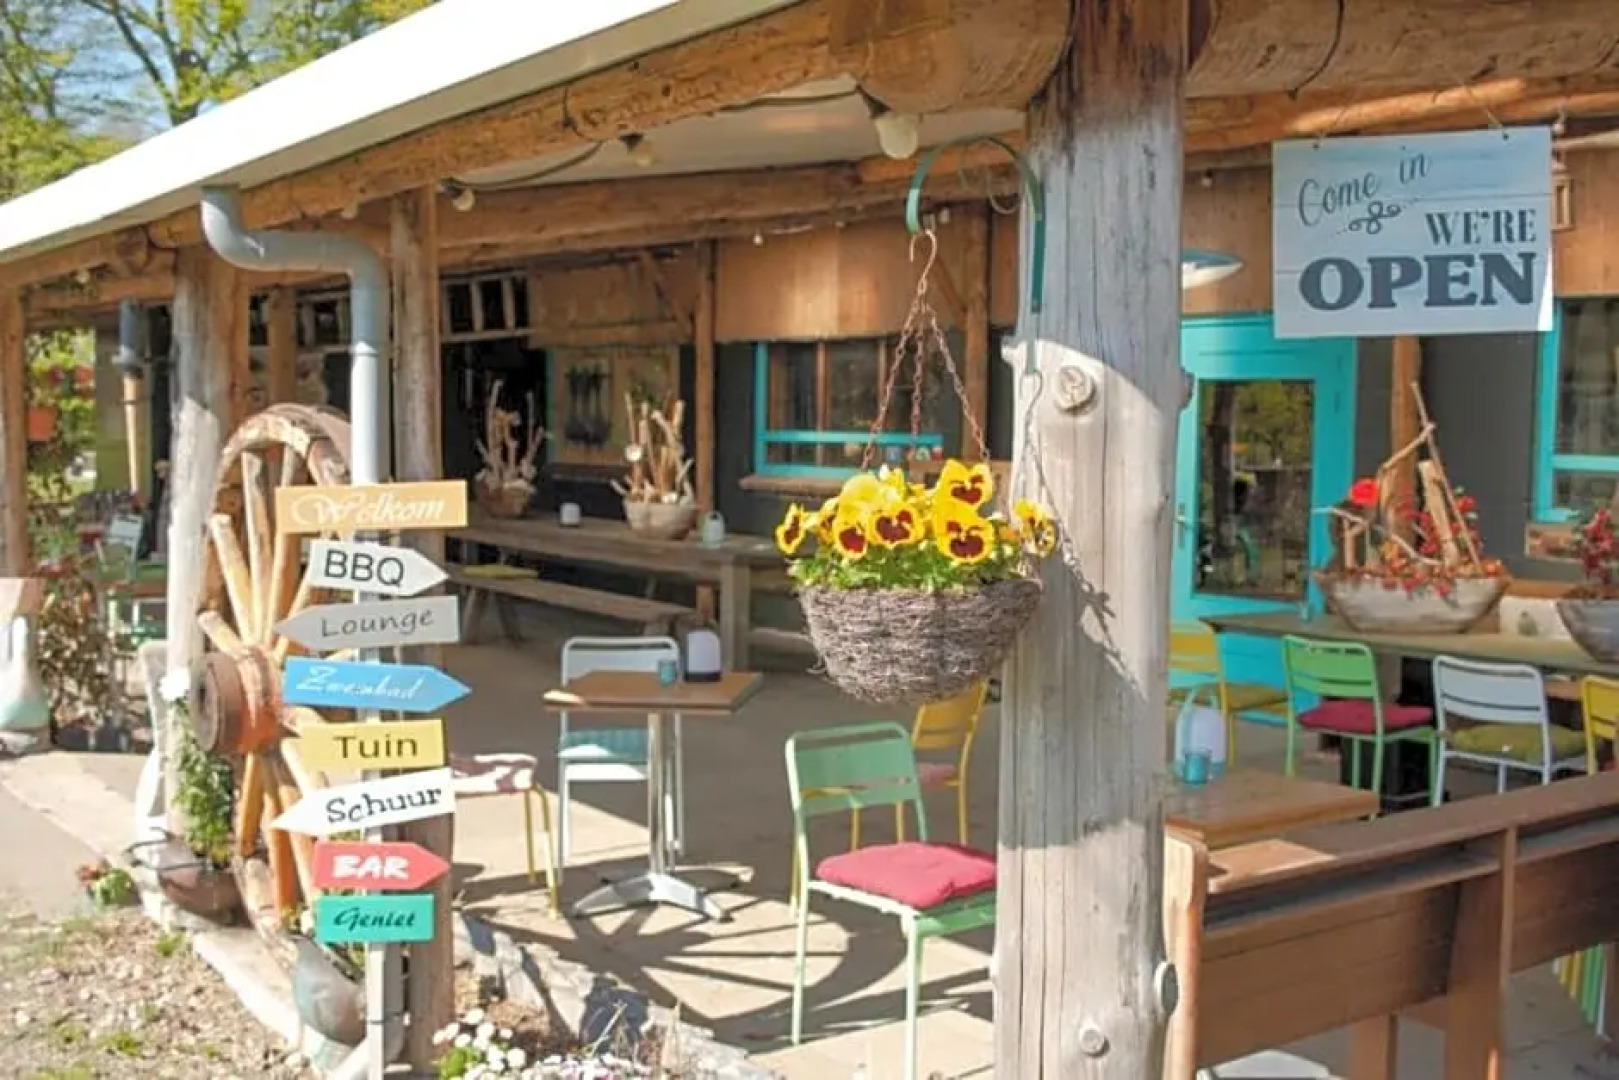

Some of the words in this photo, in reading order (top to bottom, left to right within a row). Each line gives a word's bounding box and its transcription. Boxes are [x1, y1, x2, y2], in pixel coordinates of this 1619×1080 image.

[1298, 172, 1381, 226] Come
[1399, 145, 1432, 184] in
[1424, 209, 1537, 246] WE'RE
[1299, 252, 1537, 311] OPEN
[291, 492, 444, 526] Welkom
[325, 549, 405, 588] BBQ
[321, 609, 435, 638] Lounge
[333, 733, 418, 759] Tuin
[325, 788, 442, 824] Schuur
[332, 854, 410, 880] BAR
[333, 907, 416, 931] Geniet
